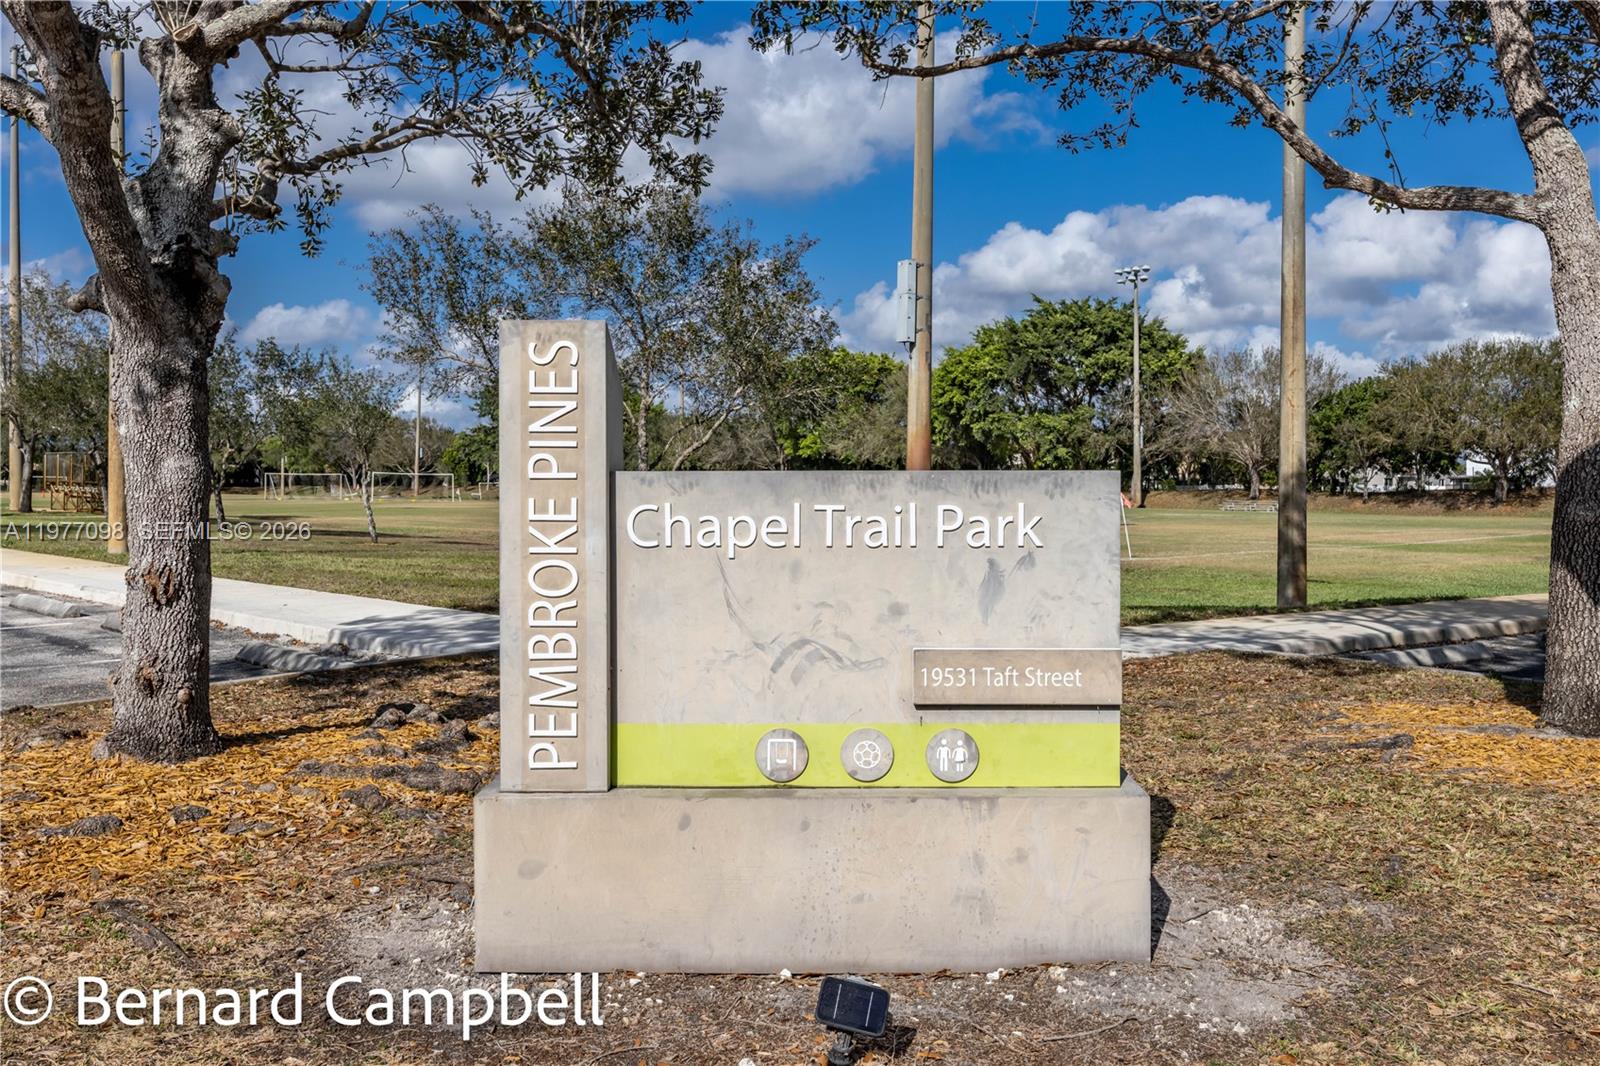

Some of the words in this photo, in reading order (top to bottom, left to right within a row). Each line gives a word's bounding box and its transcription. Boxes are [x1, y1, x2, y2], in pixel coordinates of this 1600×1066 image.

[528, 340, 580, 479] PINES
[626, 502, 801, 560] Chapel
[814, 502, 918, 549] Trail
[936, 502, 1044, 549] Park
[528, 497, 579, 771] PEMBROKE
[920, 667, 976, 688] 19531
[983, 666, 1019, 688] Taft
[1024, 667, 1083, 688] Street
